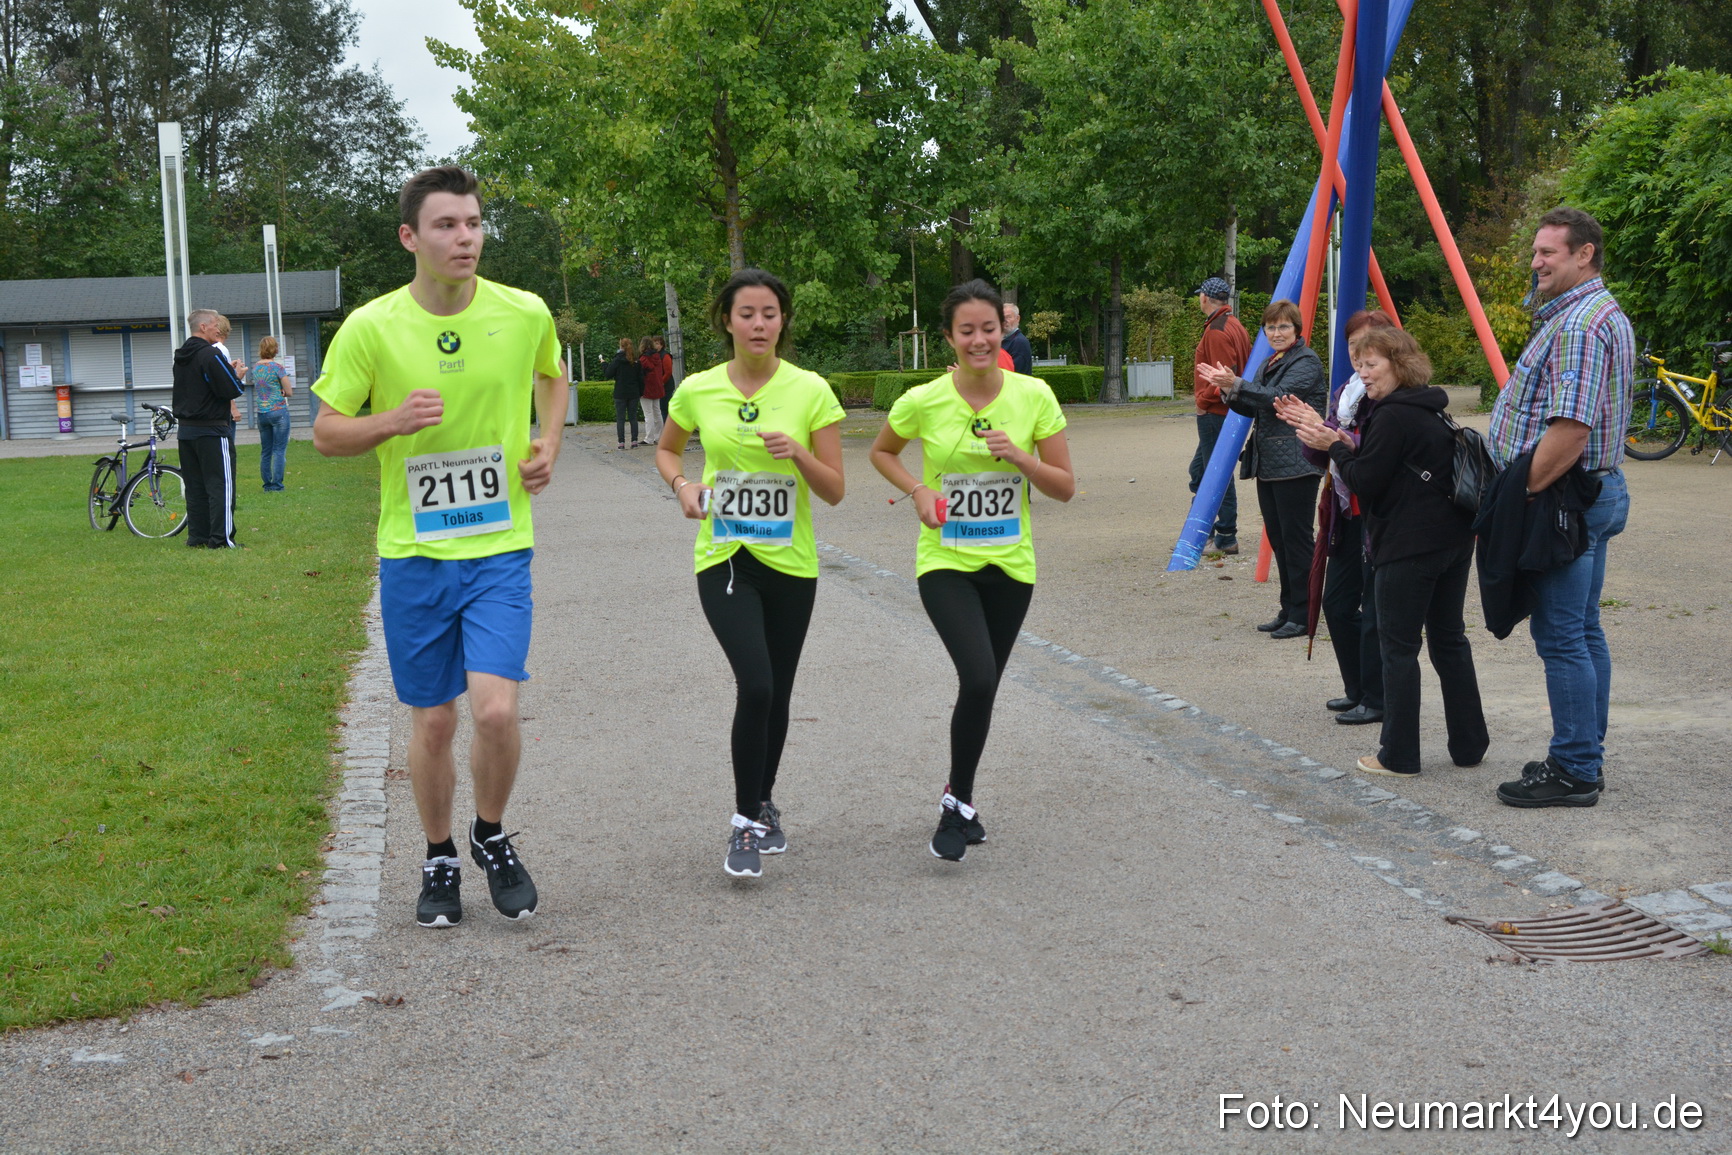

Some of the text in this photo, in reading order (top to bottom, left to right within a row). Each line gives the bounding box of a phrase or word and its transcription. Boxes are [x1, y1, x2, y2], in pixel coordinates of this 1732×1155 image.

[439, 358, 464, 370] Partl
[737, 423, 760, 433] Partl
[408, 455, 488, 474] PARTL Neumarkt
[419, 467, 499, 507] 2119
[716, 475, 782, 486] PARTL Neumarkt
[943, 478, 1009, 487] PARTL Neumarkt
[721, 488, 788, 517] 2030
[949, 488, 1014, 517] 2032
[441, 511, 484, 527] Tobias
[735, 523, 772, 536] Nadine
[960, 524, 1005, 536] Vanessa
